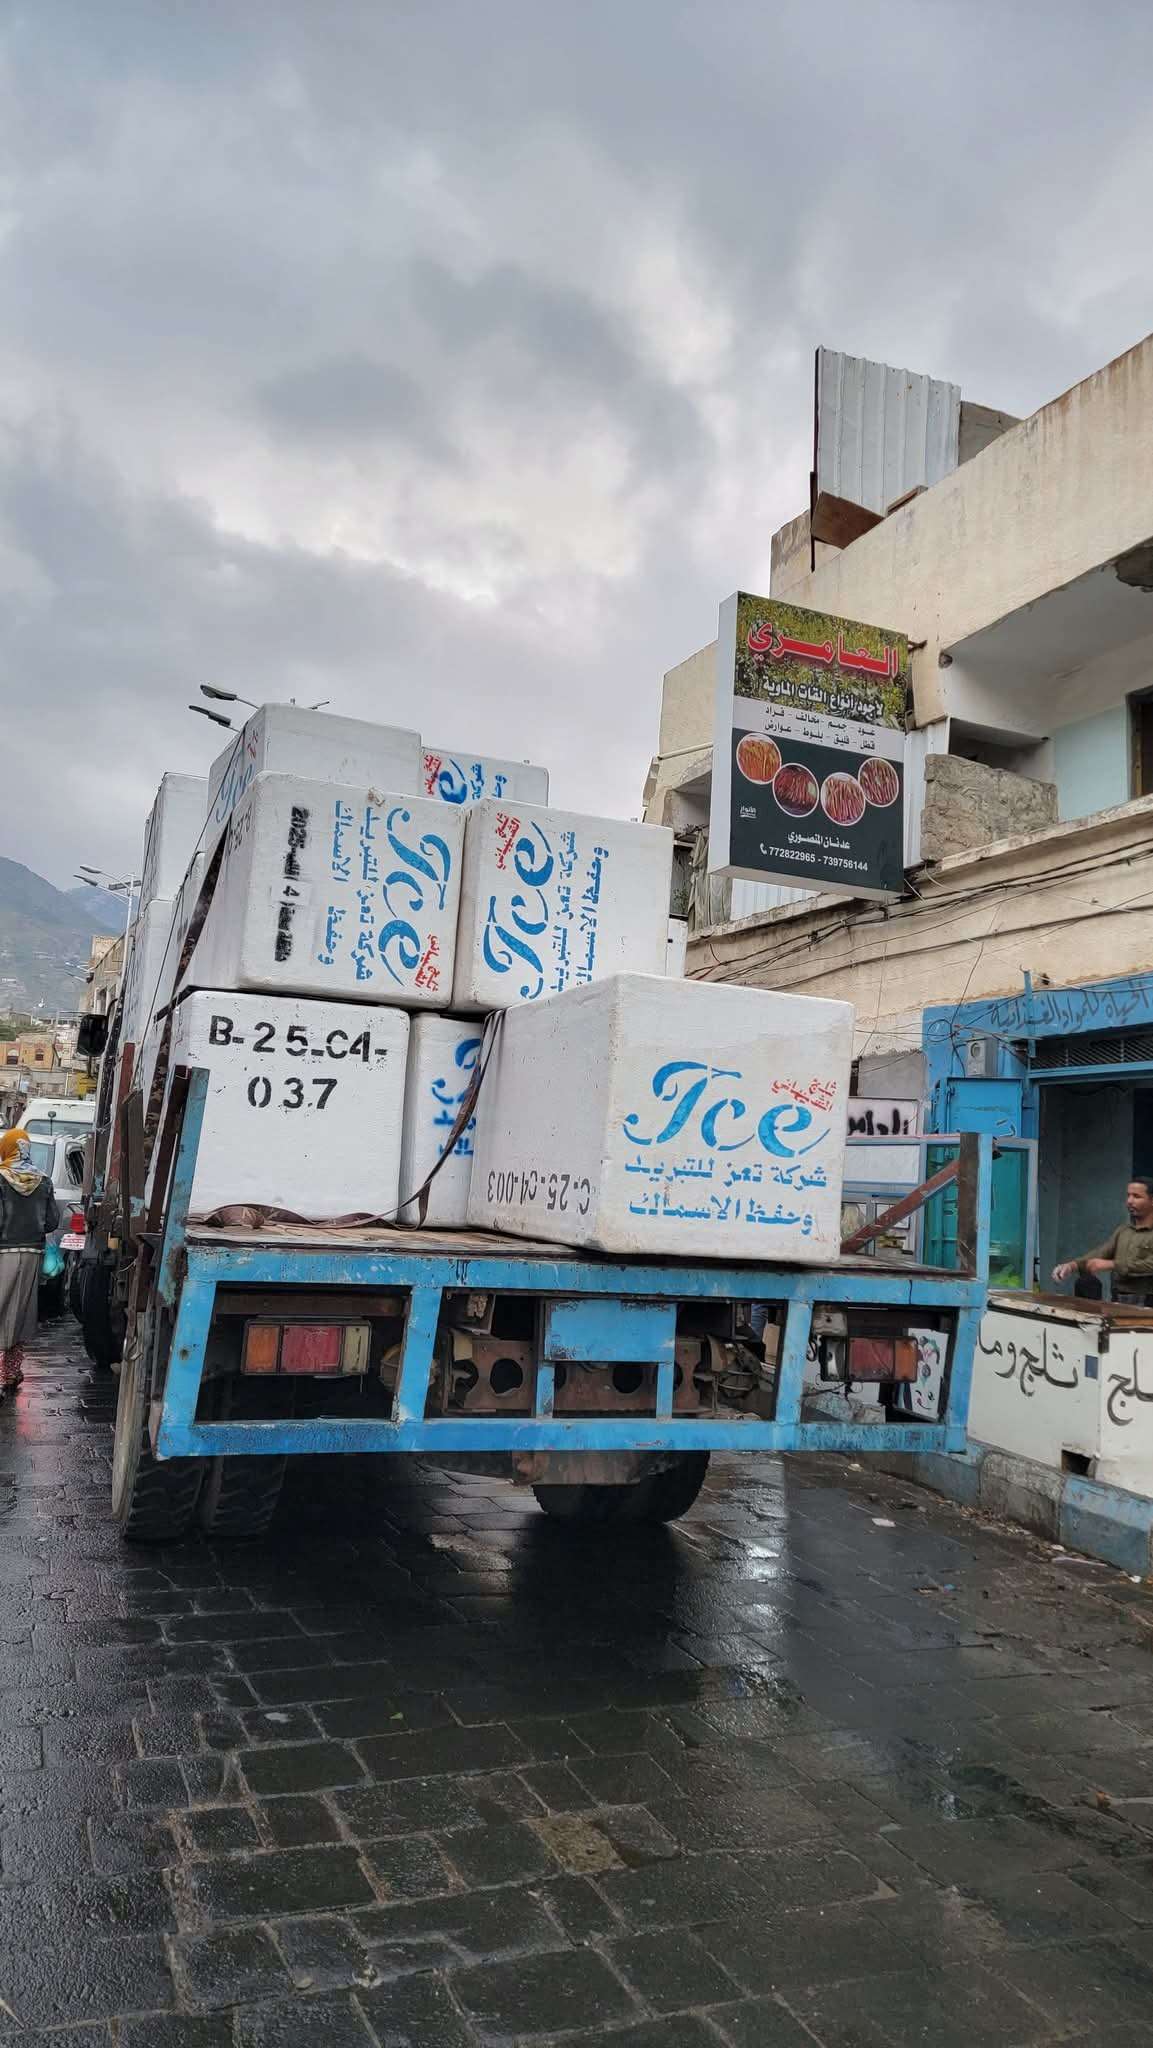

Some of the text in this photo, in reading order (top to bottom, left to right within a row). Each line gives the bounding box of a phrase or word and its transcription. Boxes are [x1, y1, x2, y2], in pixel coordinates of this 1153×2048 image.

[747, 623, 899, 678] العامري
[798, 683, 827, 704] القات
[558, 831, 578, 880] شركة
[769, 846, 868, 872] 772822965 739756144
[787, 831, 851, 849] عدنان المنصوري
[351, 807, 381, 981] شركة تعز للتبريد
[556, 886, 574, 920] تعز
[247, 1076, 338, 1110] 037
[621, 1060, 832, 1157] Ice
[625, 1154, 828, 1190] شركة تعز للتبريد
[1019, 1327, 1081, 1397] ثلج
[1106, 1347, 1153, 1427] لج
